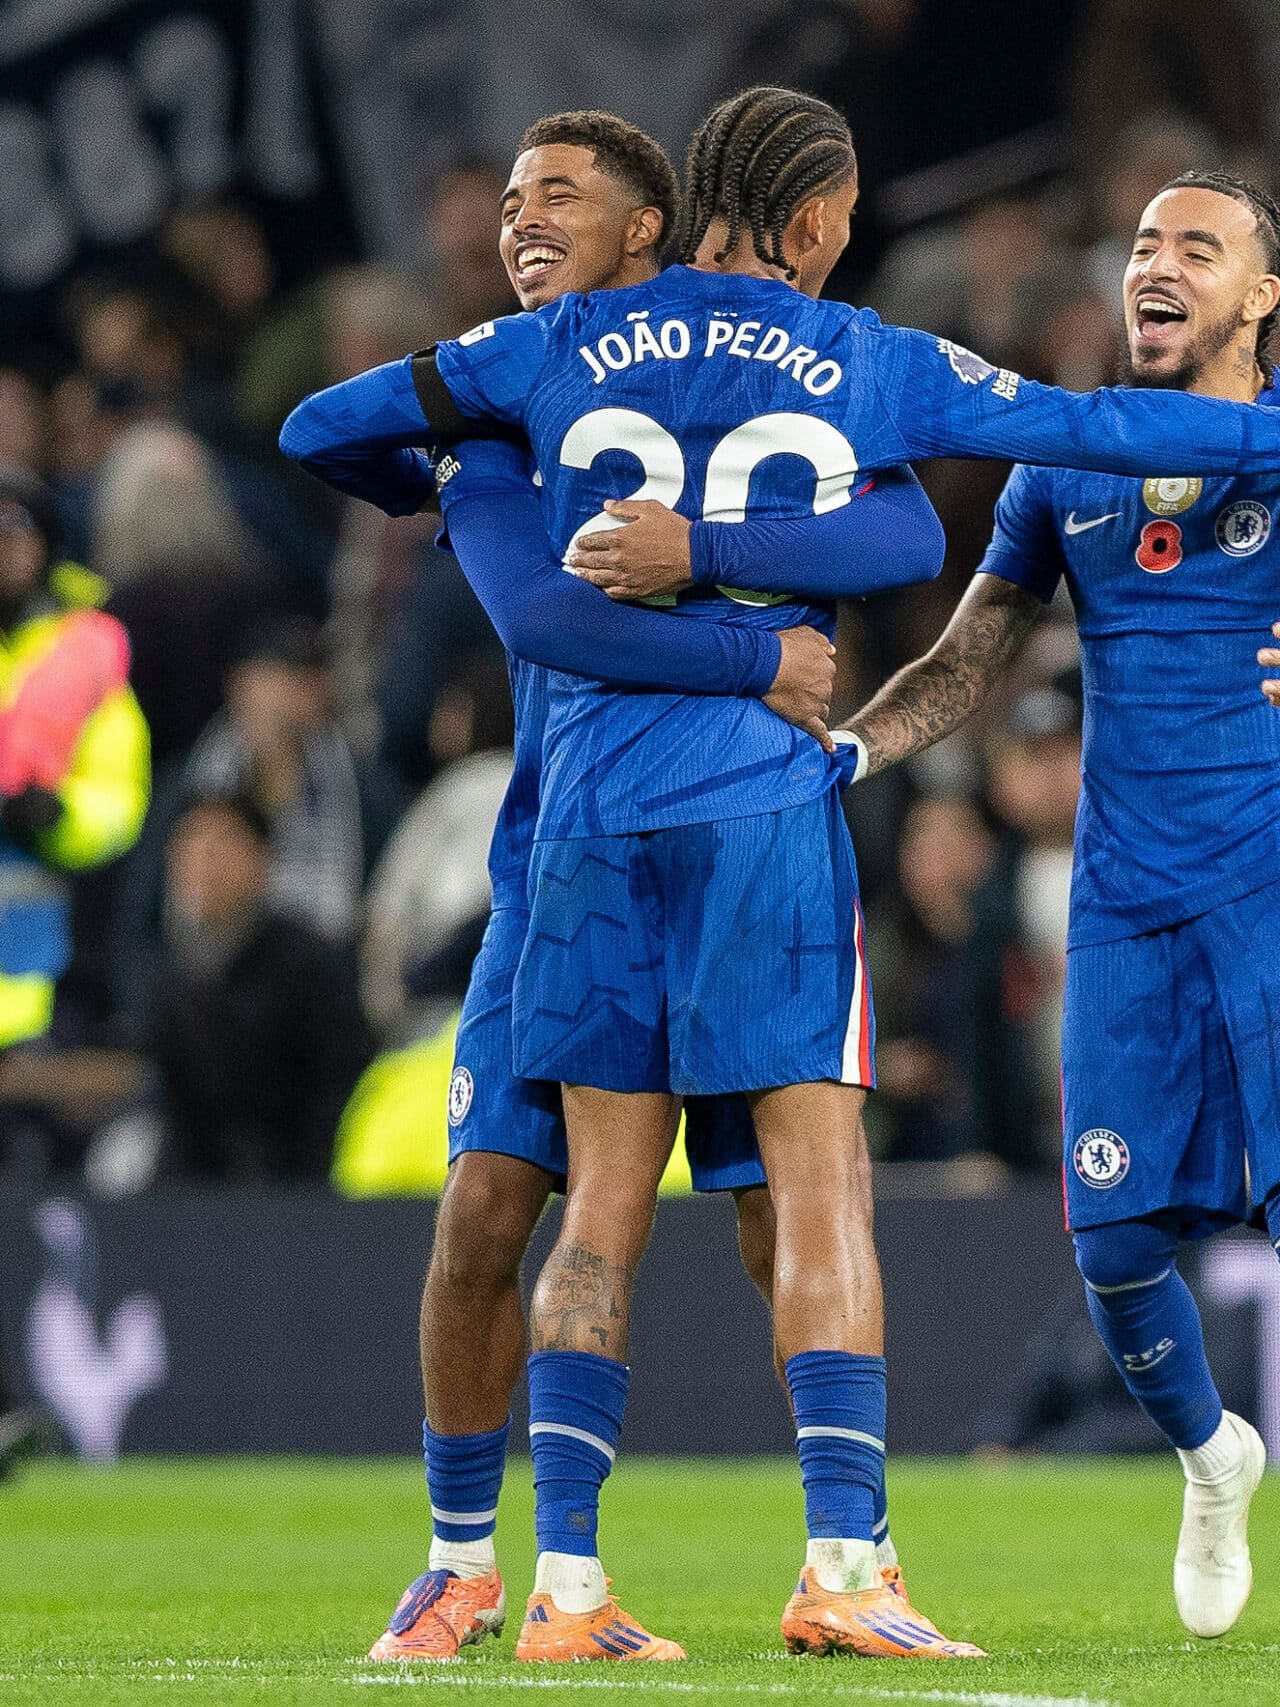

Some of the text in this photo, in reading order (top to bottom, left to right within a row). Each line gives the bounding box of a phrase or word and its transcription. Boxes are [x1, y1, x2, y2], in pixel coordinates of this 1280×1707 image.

[578, 310, 843, 397] JOÃO PEDRO
[559, 406, 859, 607] 20
